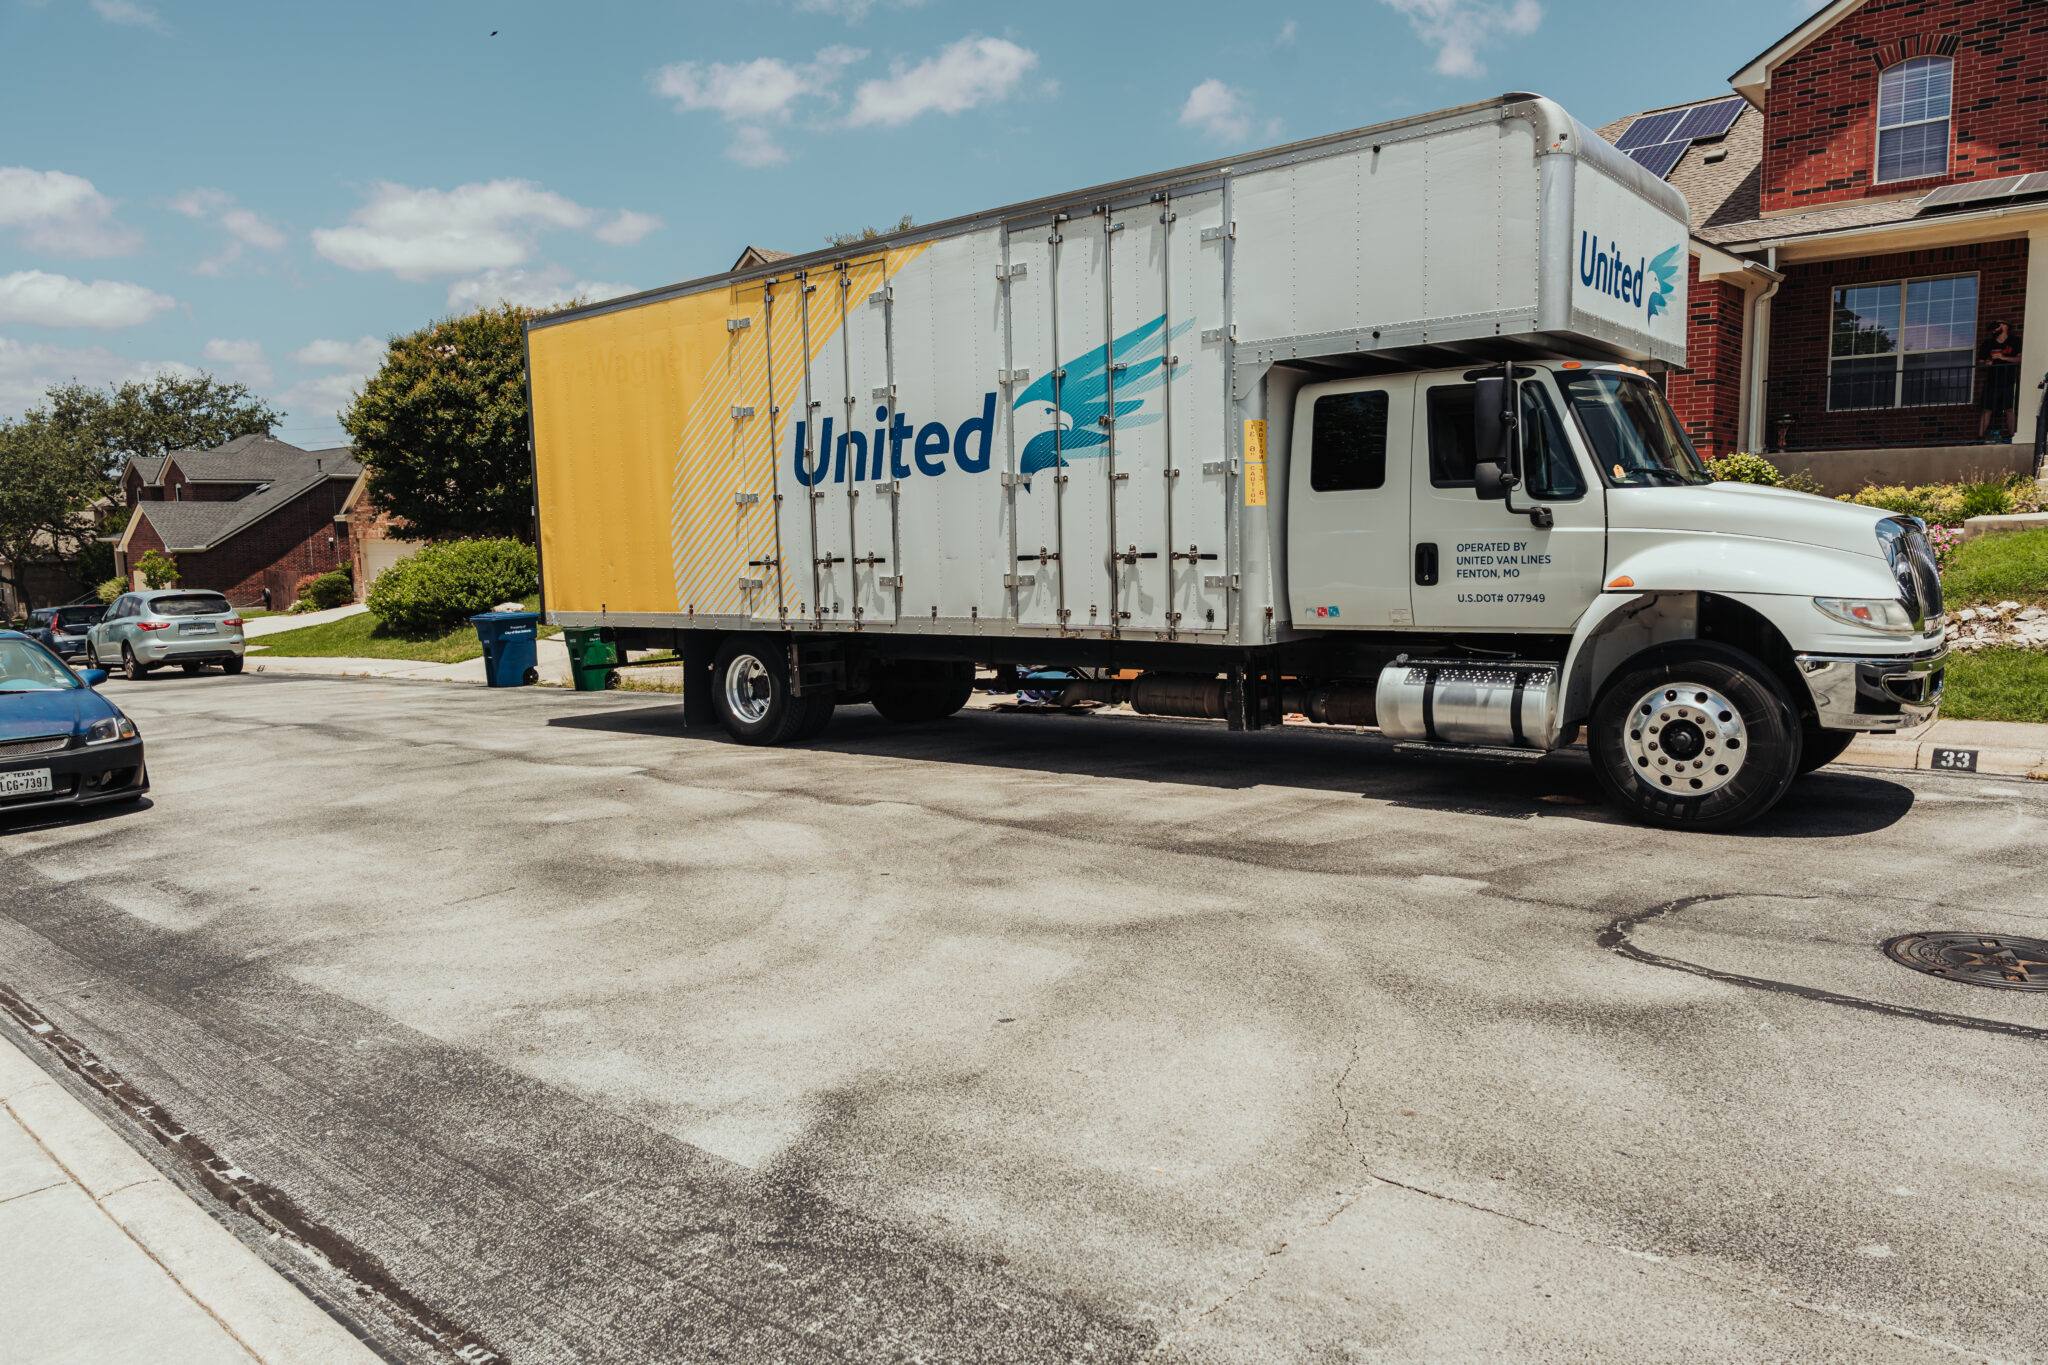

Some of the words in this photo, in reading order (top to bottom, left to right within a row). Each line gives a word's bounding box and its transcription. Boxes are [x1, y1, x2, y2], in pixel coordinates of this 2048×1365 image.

[1580, 230, 1645, 308] United
[793, 391, 998, 487] United
[1456, 543, 1510, 552] OPERATED
[1513, 542, 1527, 551] BY
[1456, 555, 1494, 566] UNITED
[1496, 555, 1518, 565] VAN
[1521, 554, 1552, 565] LINES
[1456, 568, 1501, 579] FENTON,
[1503, 568, 1520, 578] MO
[1457, 593, 1504, 603] U.S.DOT#
[1506, 593, 1546, 603] 077949
[1940, 751, 1970, 768] 33
